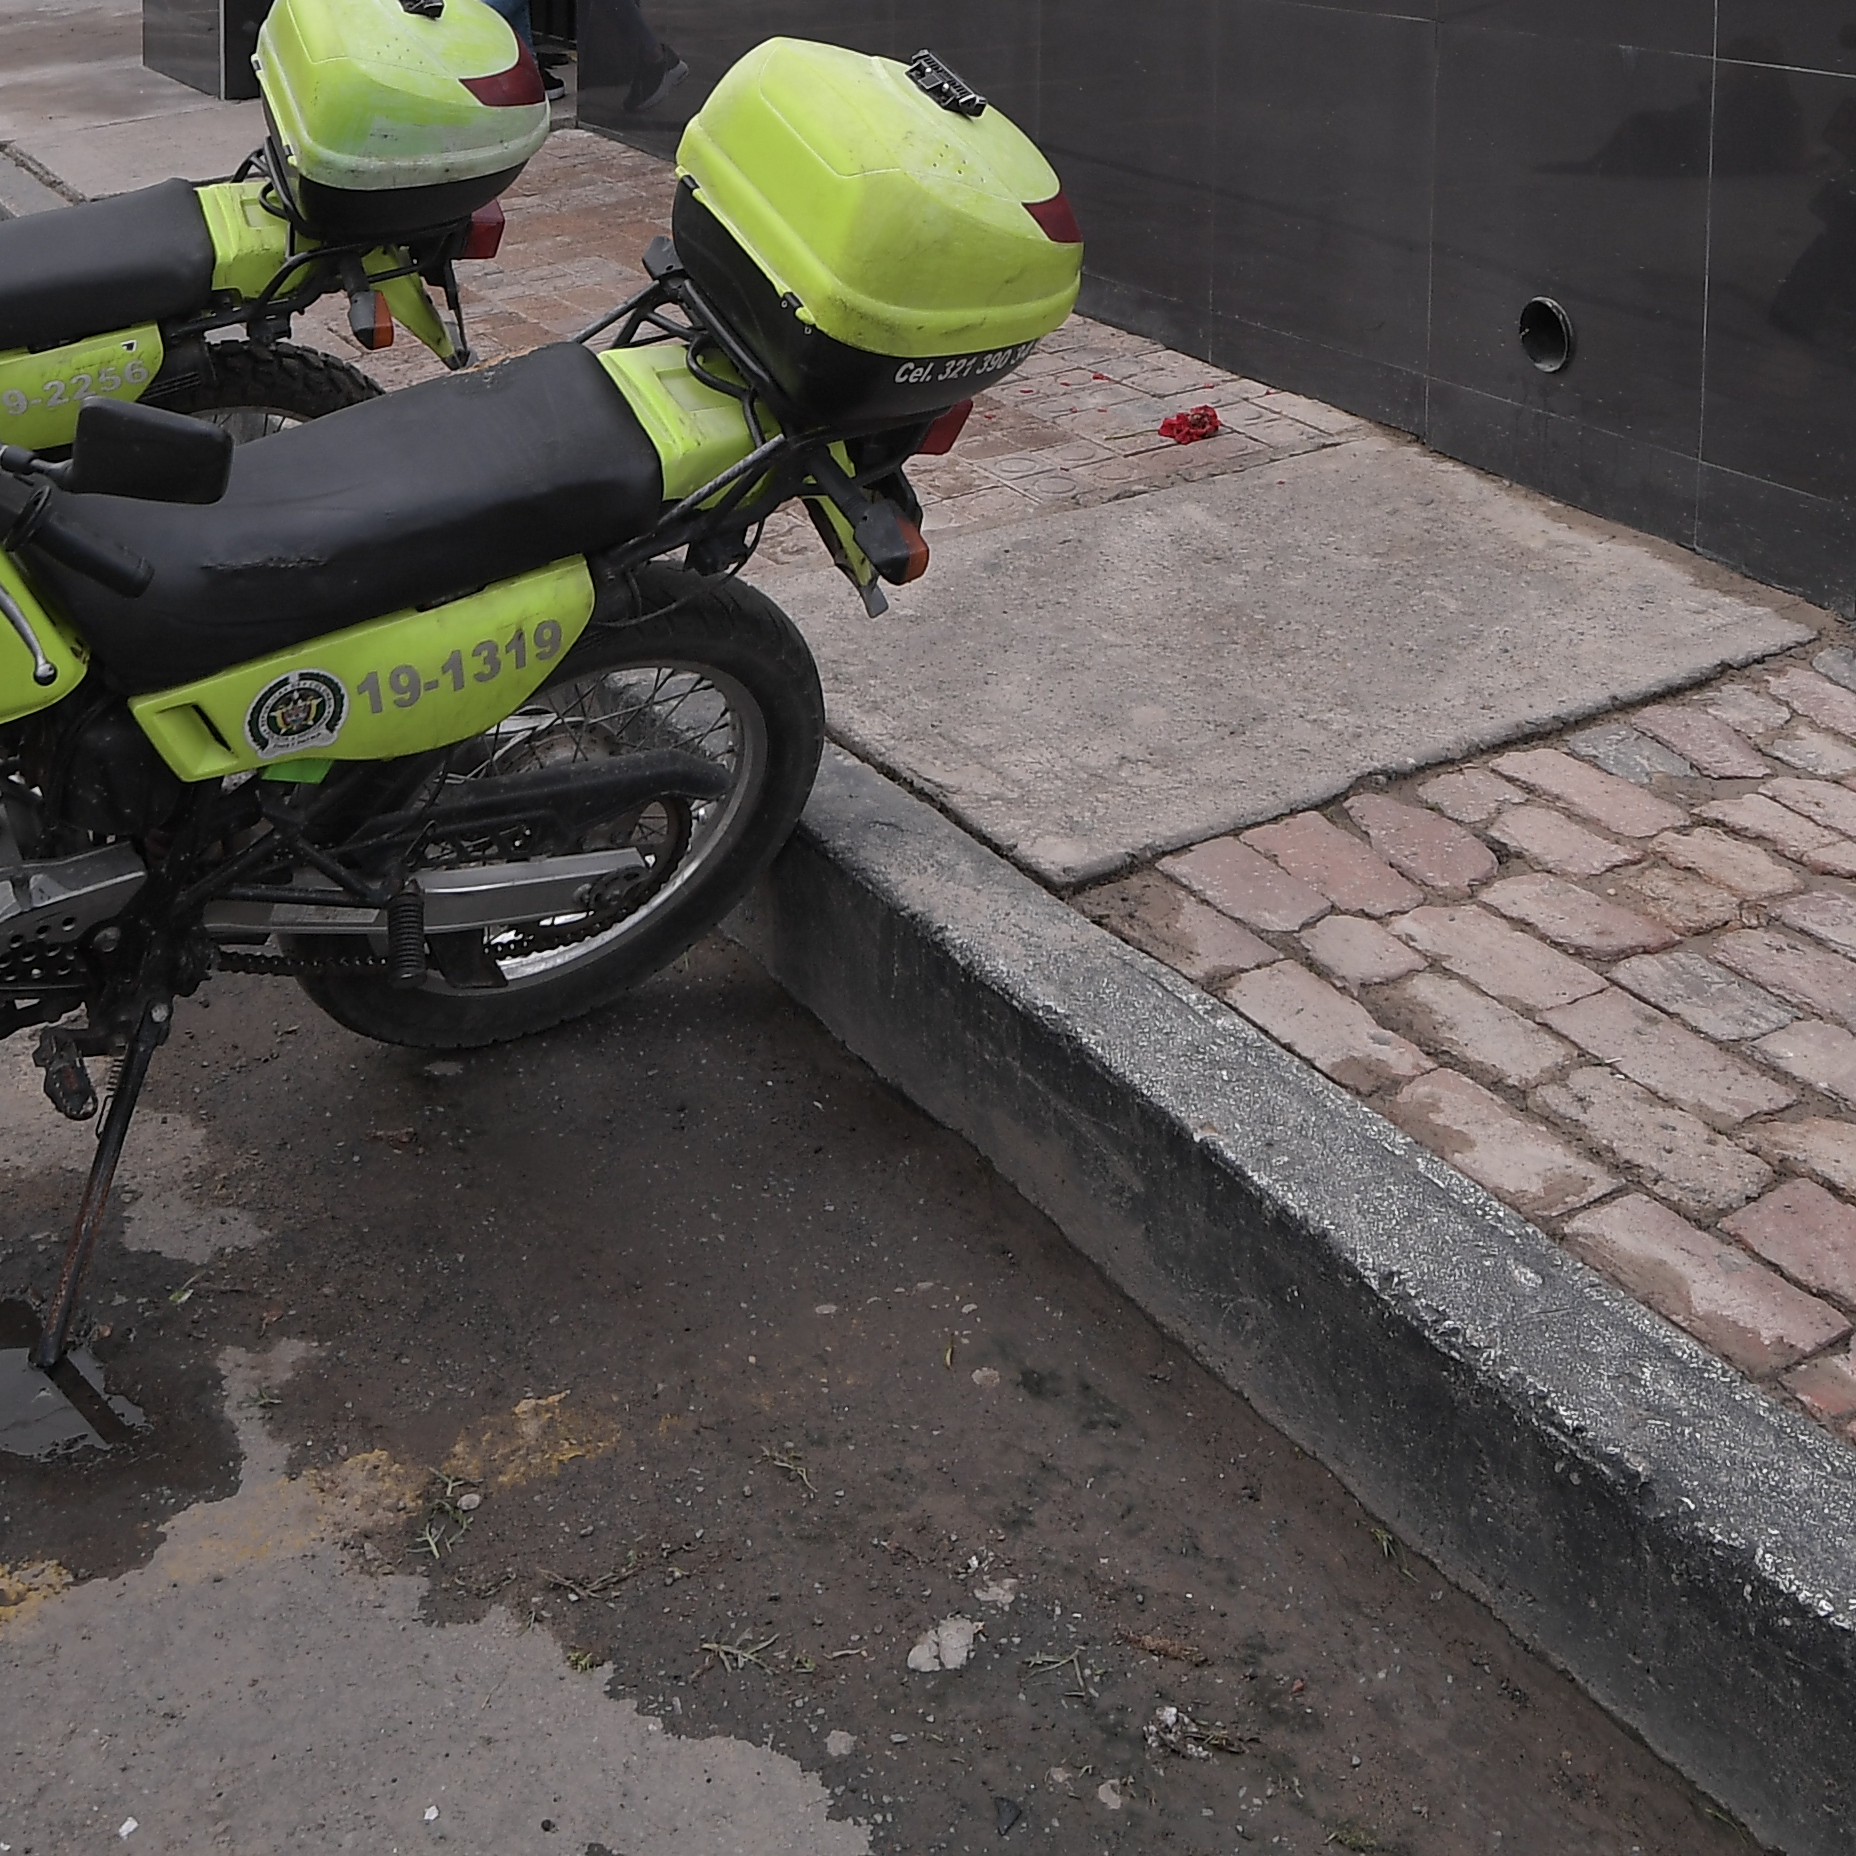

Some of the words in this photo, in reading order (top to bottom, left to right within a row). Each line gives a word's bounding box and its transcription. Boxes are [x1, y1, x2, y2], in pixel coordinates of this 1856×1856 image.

[894, 362, 934, 383] Cel.
[938, 356, 977, 381] 321
[976, 348, 1012, 375] 390
[357, 619, 562, 714] 19-1319
